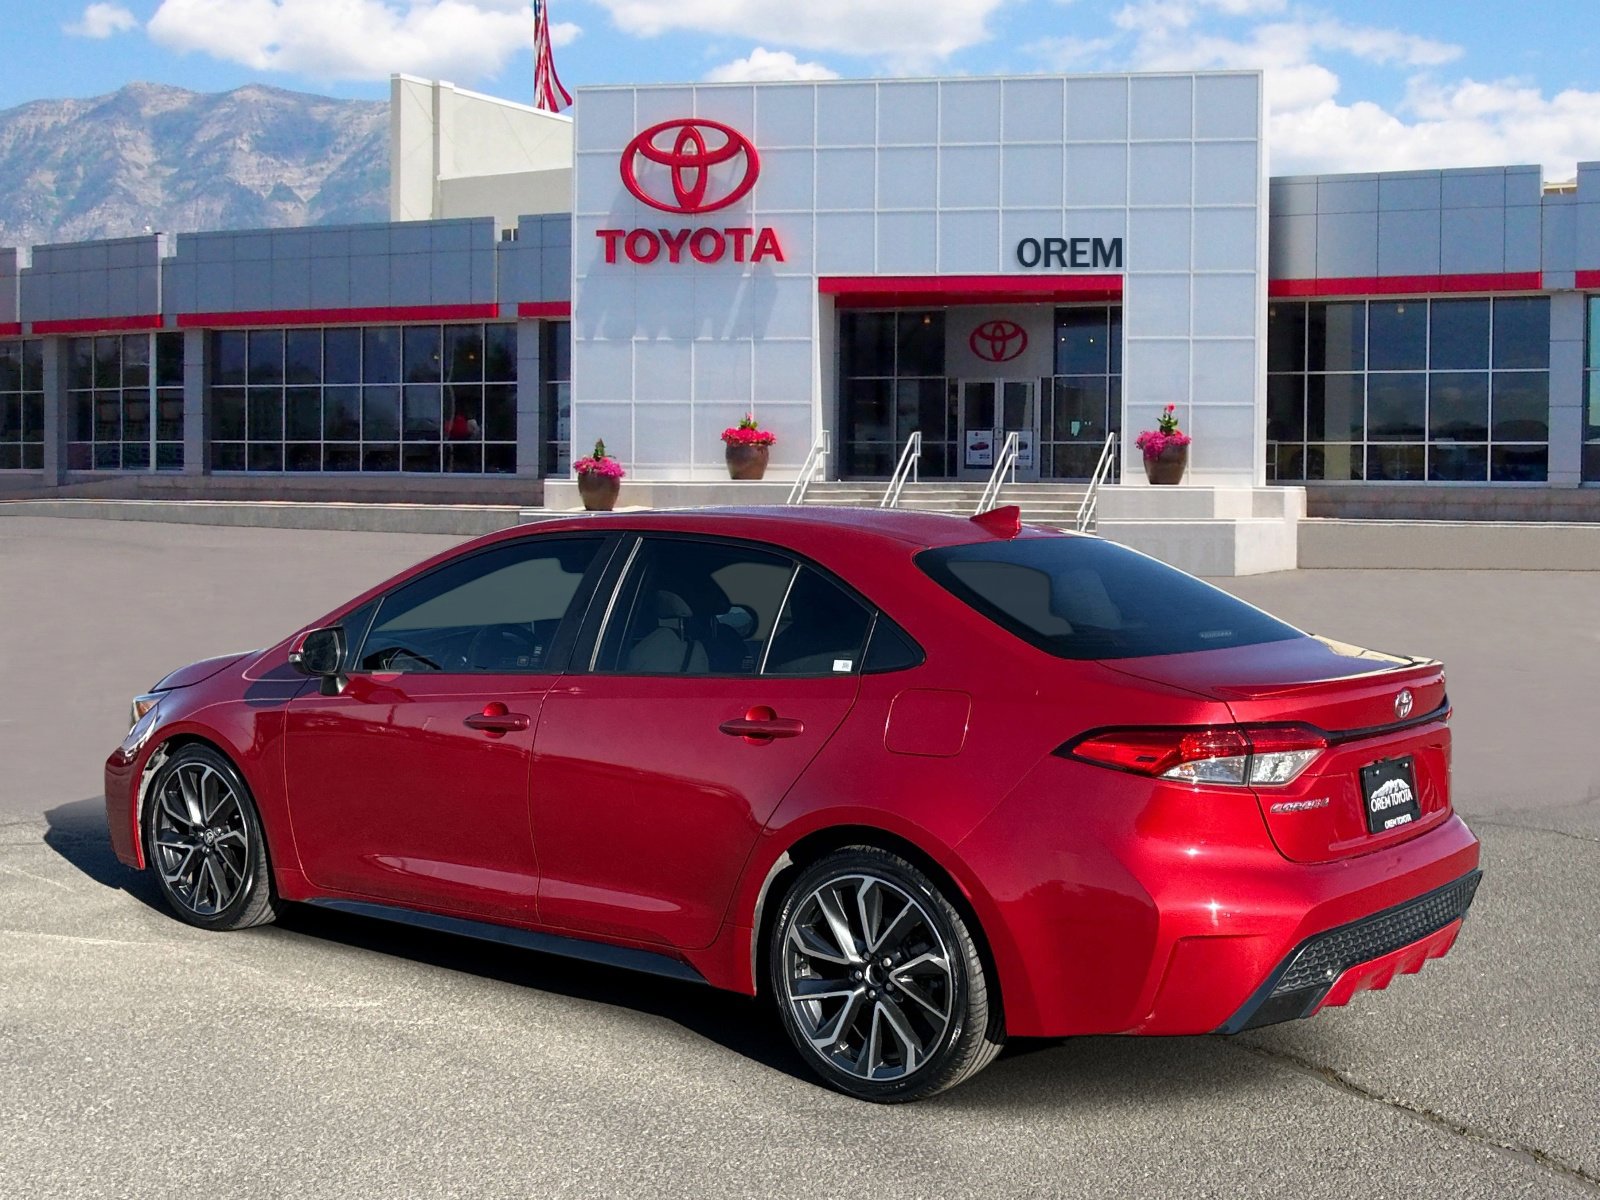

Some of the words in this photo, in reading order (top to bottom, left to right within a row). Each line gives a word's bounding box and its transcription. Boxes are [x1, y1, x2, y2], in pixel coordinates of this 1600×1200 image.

[595, 227, 785, 264] TOYOTA
[1016, 237, 1123, 268] OREM
[1370, 794, 1391, 812] OREM
[1390, 788, 1413, 806] TOYOTA
